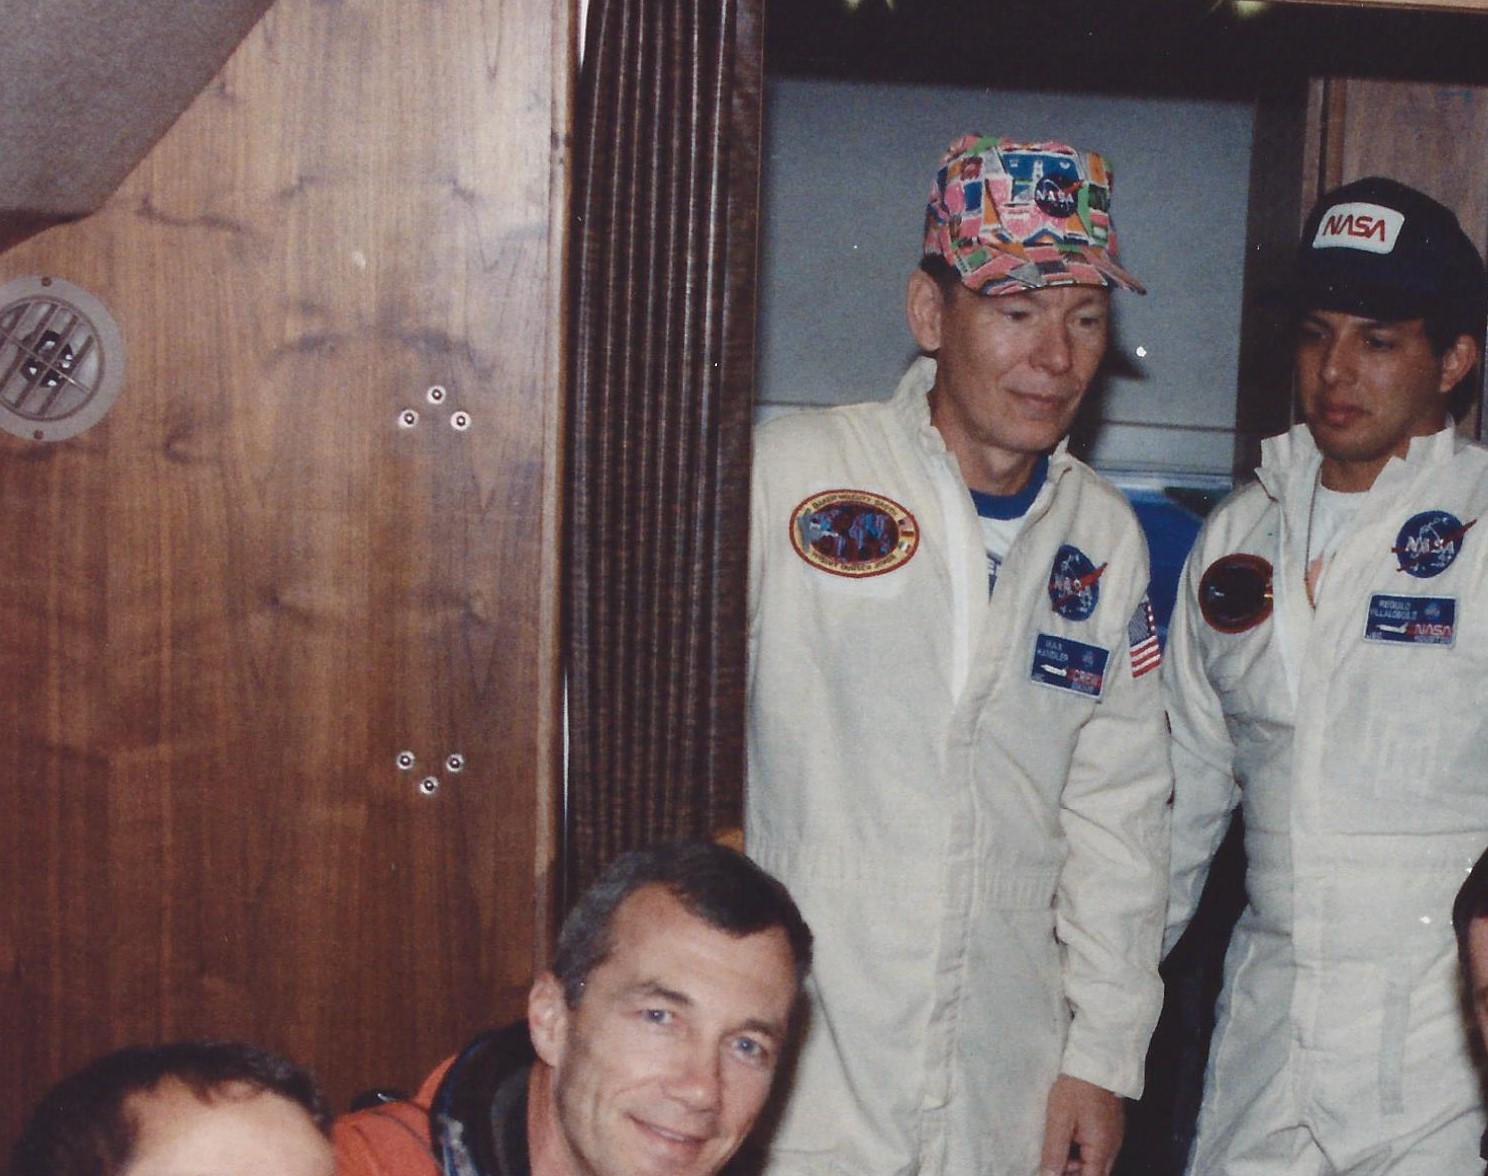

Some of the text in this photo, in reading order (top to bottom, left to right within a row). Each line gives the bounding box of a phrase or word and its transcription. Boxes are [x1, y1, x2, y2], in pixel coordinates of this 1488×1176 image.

[1035, 189, 1074, 203] NASA
[1322, 213, 1386, 243] NASA
[1405, 536, 1455, 557] NASA
[1415, 623, 1452, 636] NASA
